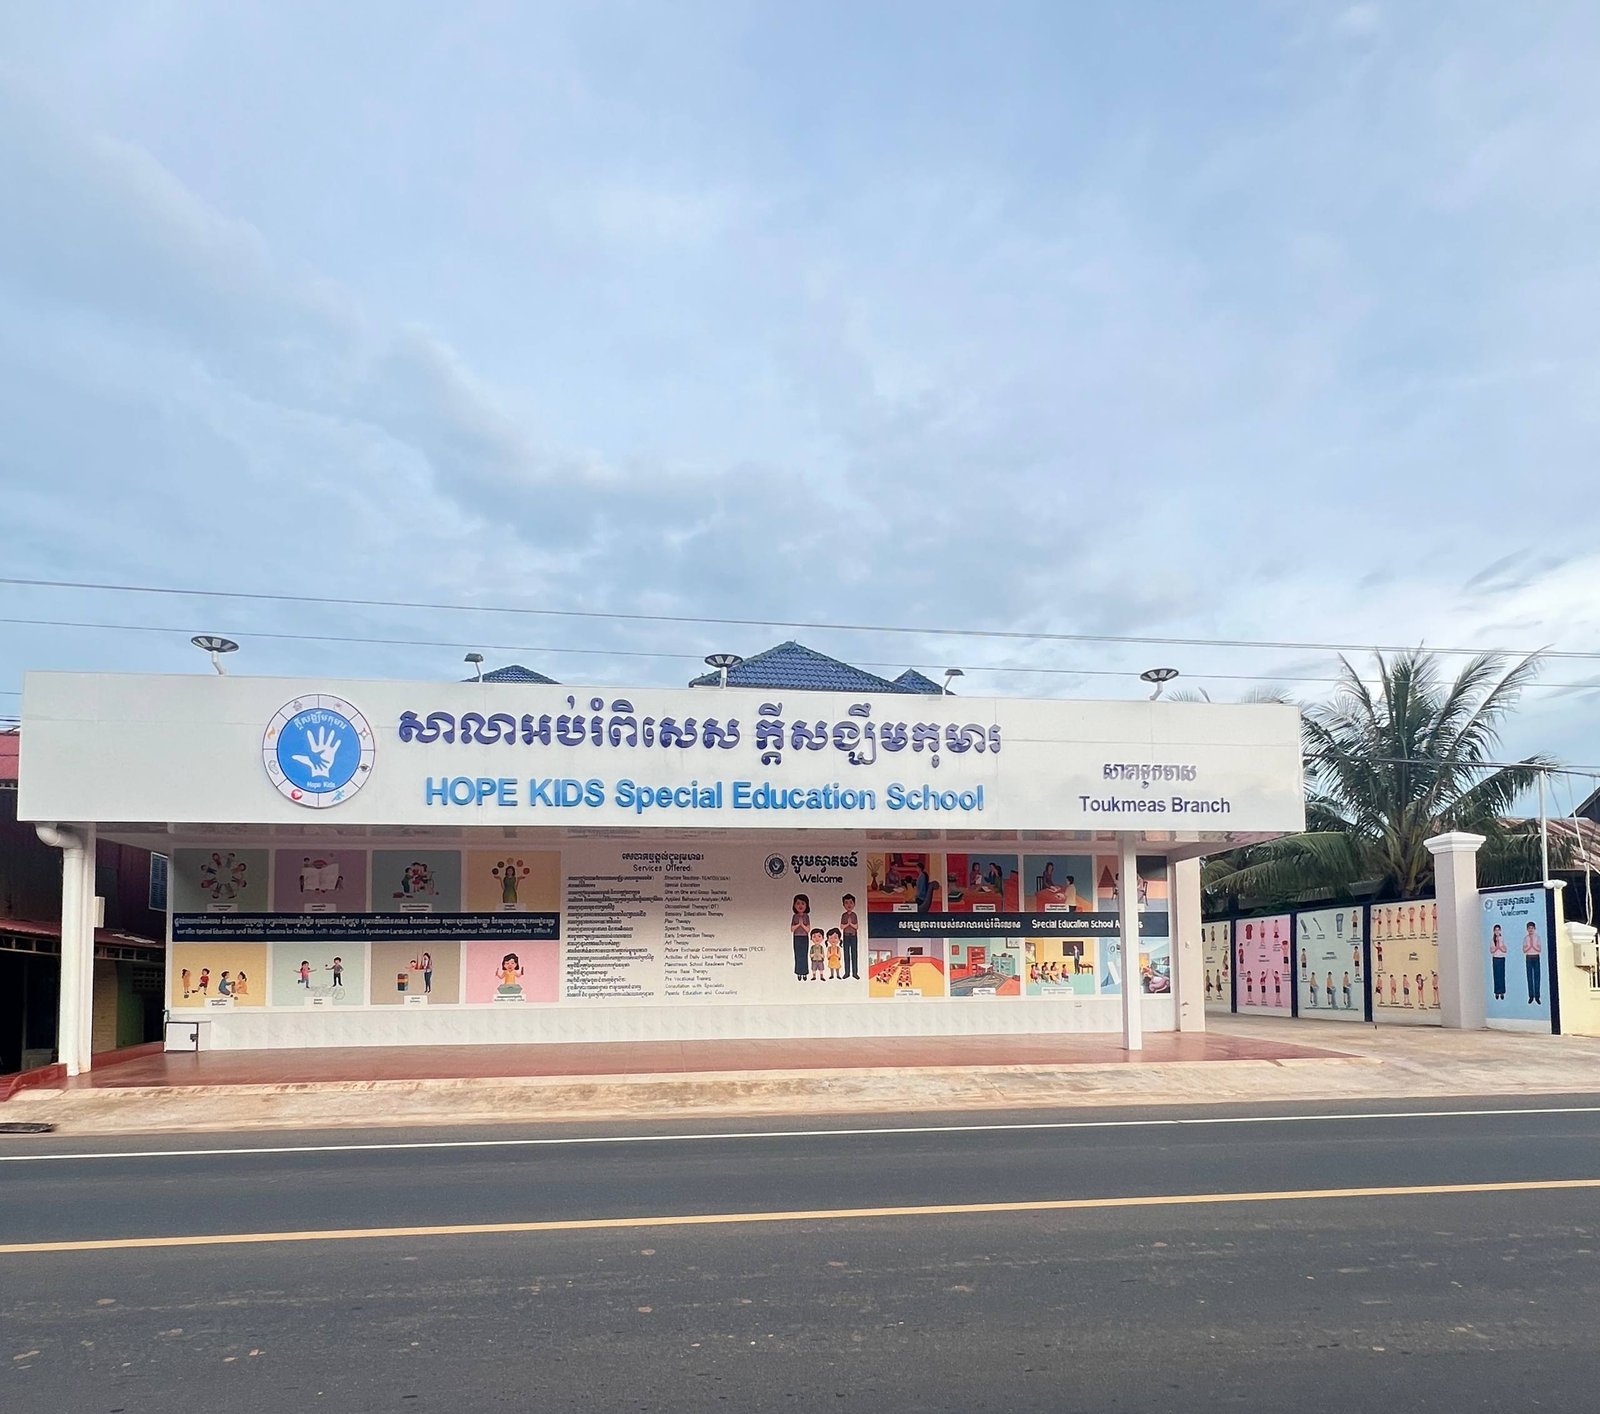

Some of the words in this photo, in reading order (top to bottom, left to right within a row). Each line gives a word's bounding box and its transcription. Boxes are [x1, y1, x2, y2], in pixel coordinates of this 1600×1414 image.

[306, 781, 322, 790] Hope
[323, 781, 336, 789] Kids
[425, 776, 519, 807] HOPE
[529, 778, 606, 808] KIDS
[614, 779, 723, 815] Special
[732, 781, 877, 811] Education
[886, 783, 984, 812] School
[1078, 796, 1167, 813] Toukmeas
[1171, 797, 1231, 814] Branch
[633, 864, 663, 872] Services
[798, 873, 843, 884] Welcome
[1500, 909, 1529, 917] Welcome
[1031, 918, 1057, 929] Special
[1058, 918, 1090, 929] Education
[1090, 919, 1113, 929] School
